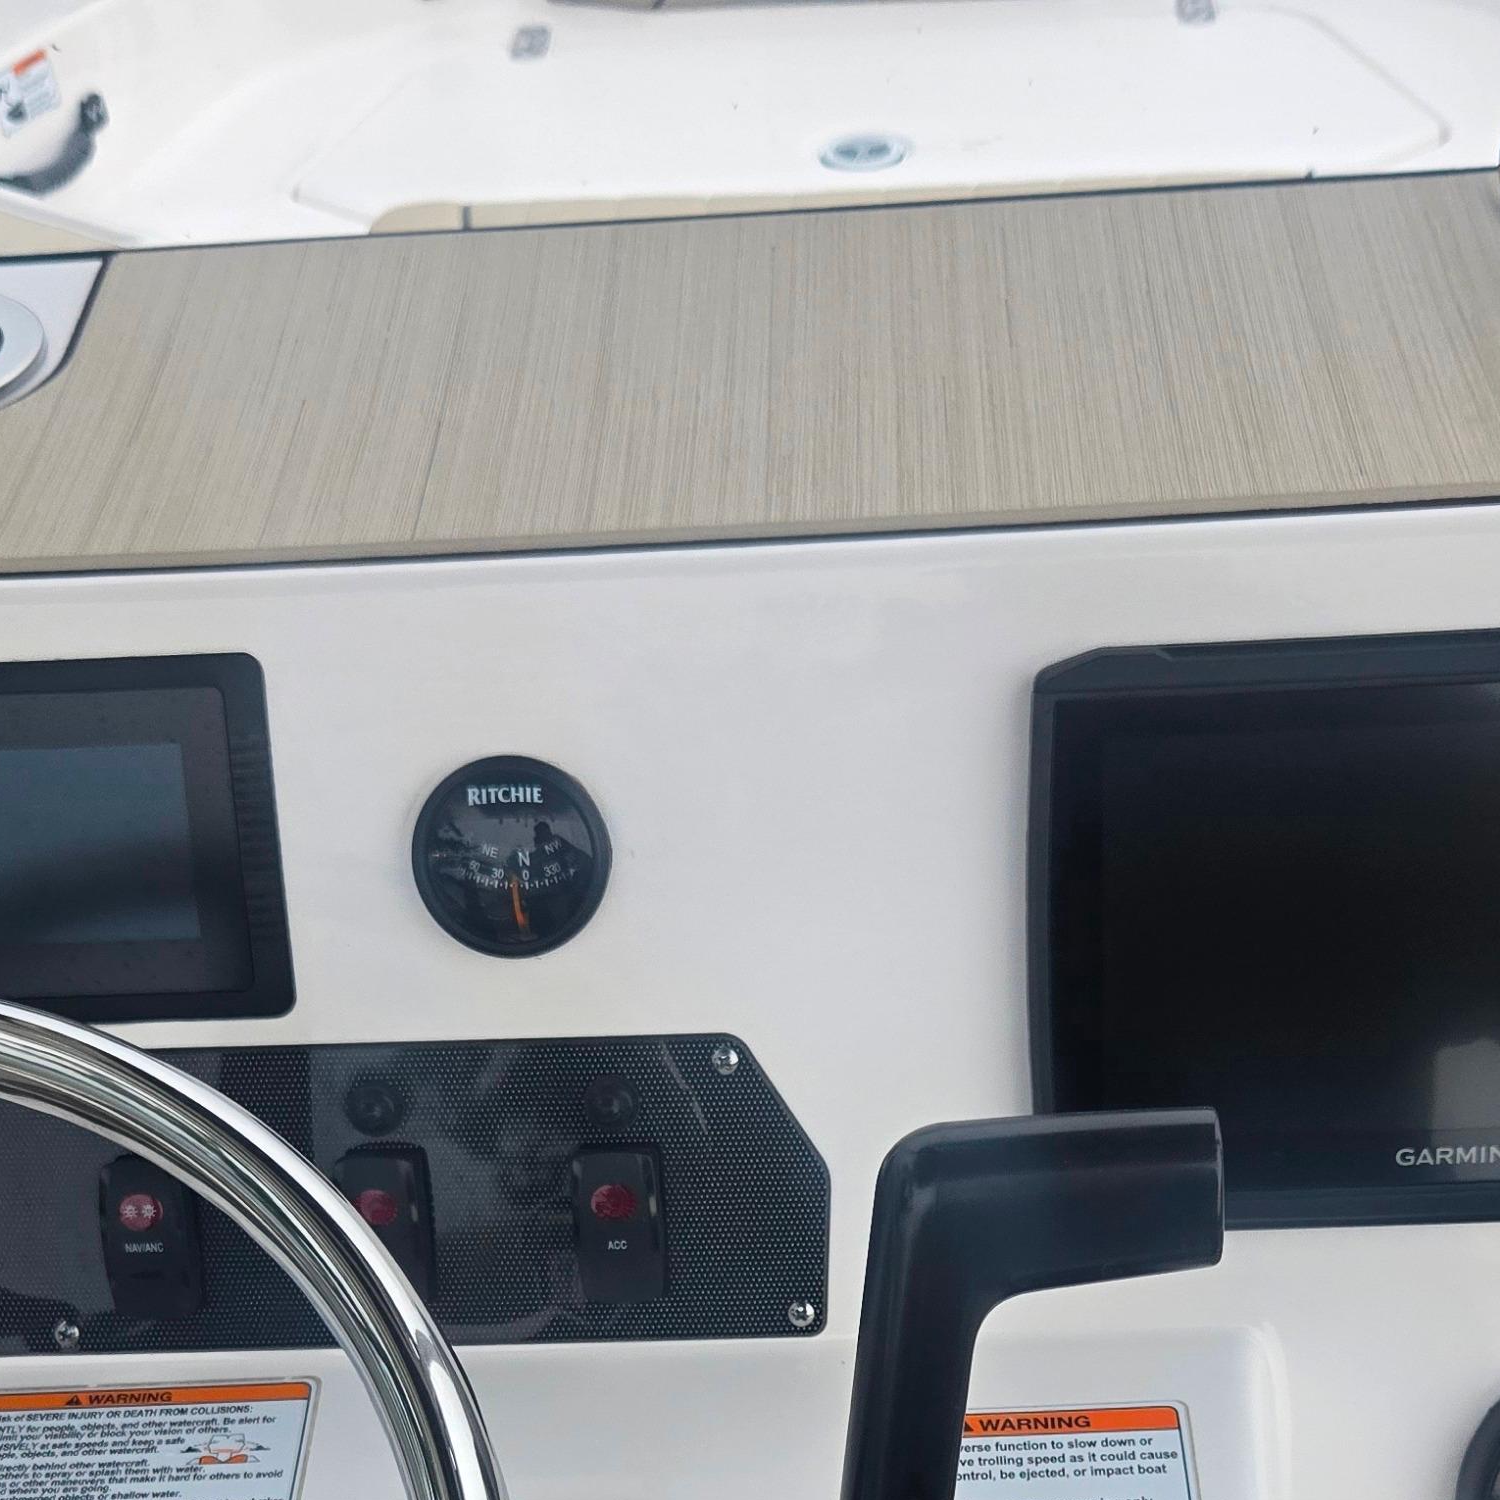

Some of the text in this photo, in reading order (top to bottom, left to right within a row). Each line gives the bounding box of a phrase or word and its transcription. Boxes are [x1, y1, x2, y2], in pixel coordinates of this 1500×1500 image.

[467, 785, 543, 806] RITCHIE
[482, 844, 499, 858] NE
[518, 851, 530, 867] N
[491, 868, 504, 879] 30
[522, 870, 529, 881] 0
[608, 1240, 627, 1250] ACC
[88, 1391, 173, 1405] WARNING
[26, 1412, 66, 1421] SEVERE
[68, 1412, 106, 1420] INJURY
[106, 1410, 121, 1418] OR
[124, 1409, 157, 1418] DEATH
[160, 1408, 188, 1416] FROM
[190, 1405, 253, 1415] COLLISIONS:
[979, 1415, 1091, 1431] WARNING
[995, 1441, 1047, 1452] function
[1051, 1440, 1064, 1449] to
[1067, 1439, 1097, 1449] slow
[1101, 1437, 1136, 1447] down
[1139, 1438, 1153, 1446] or
[978, 1456, 1023, 1467] trolling
[1027, 1453, 1065, 1466] speed
[1069, 1454, 1084, 1463] as
[1088, 1452, 1097, 1462] it
[1100, 1451, 1136, 1461] could
[1140, 1451, 1178, 1460] cause
[1000, 1469, 1015, 1479] be
[1019, 1468, 1069, 1481] ejected,
[1073, 1469, 1086, 1477] or
[1091, 1466, 1135, 1478] impact
[1138, 1464, 1167, 1474] boat
